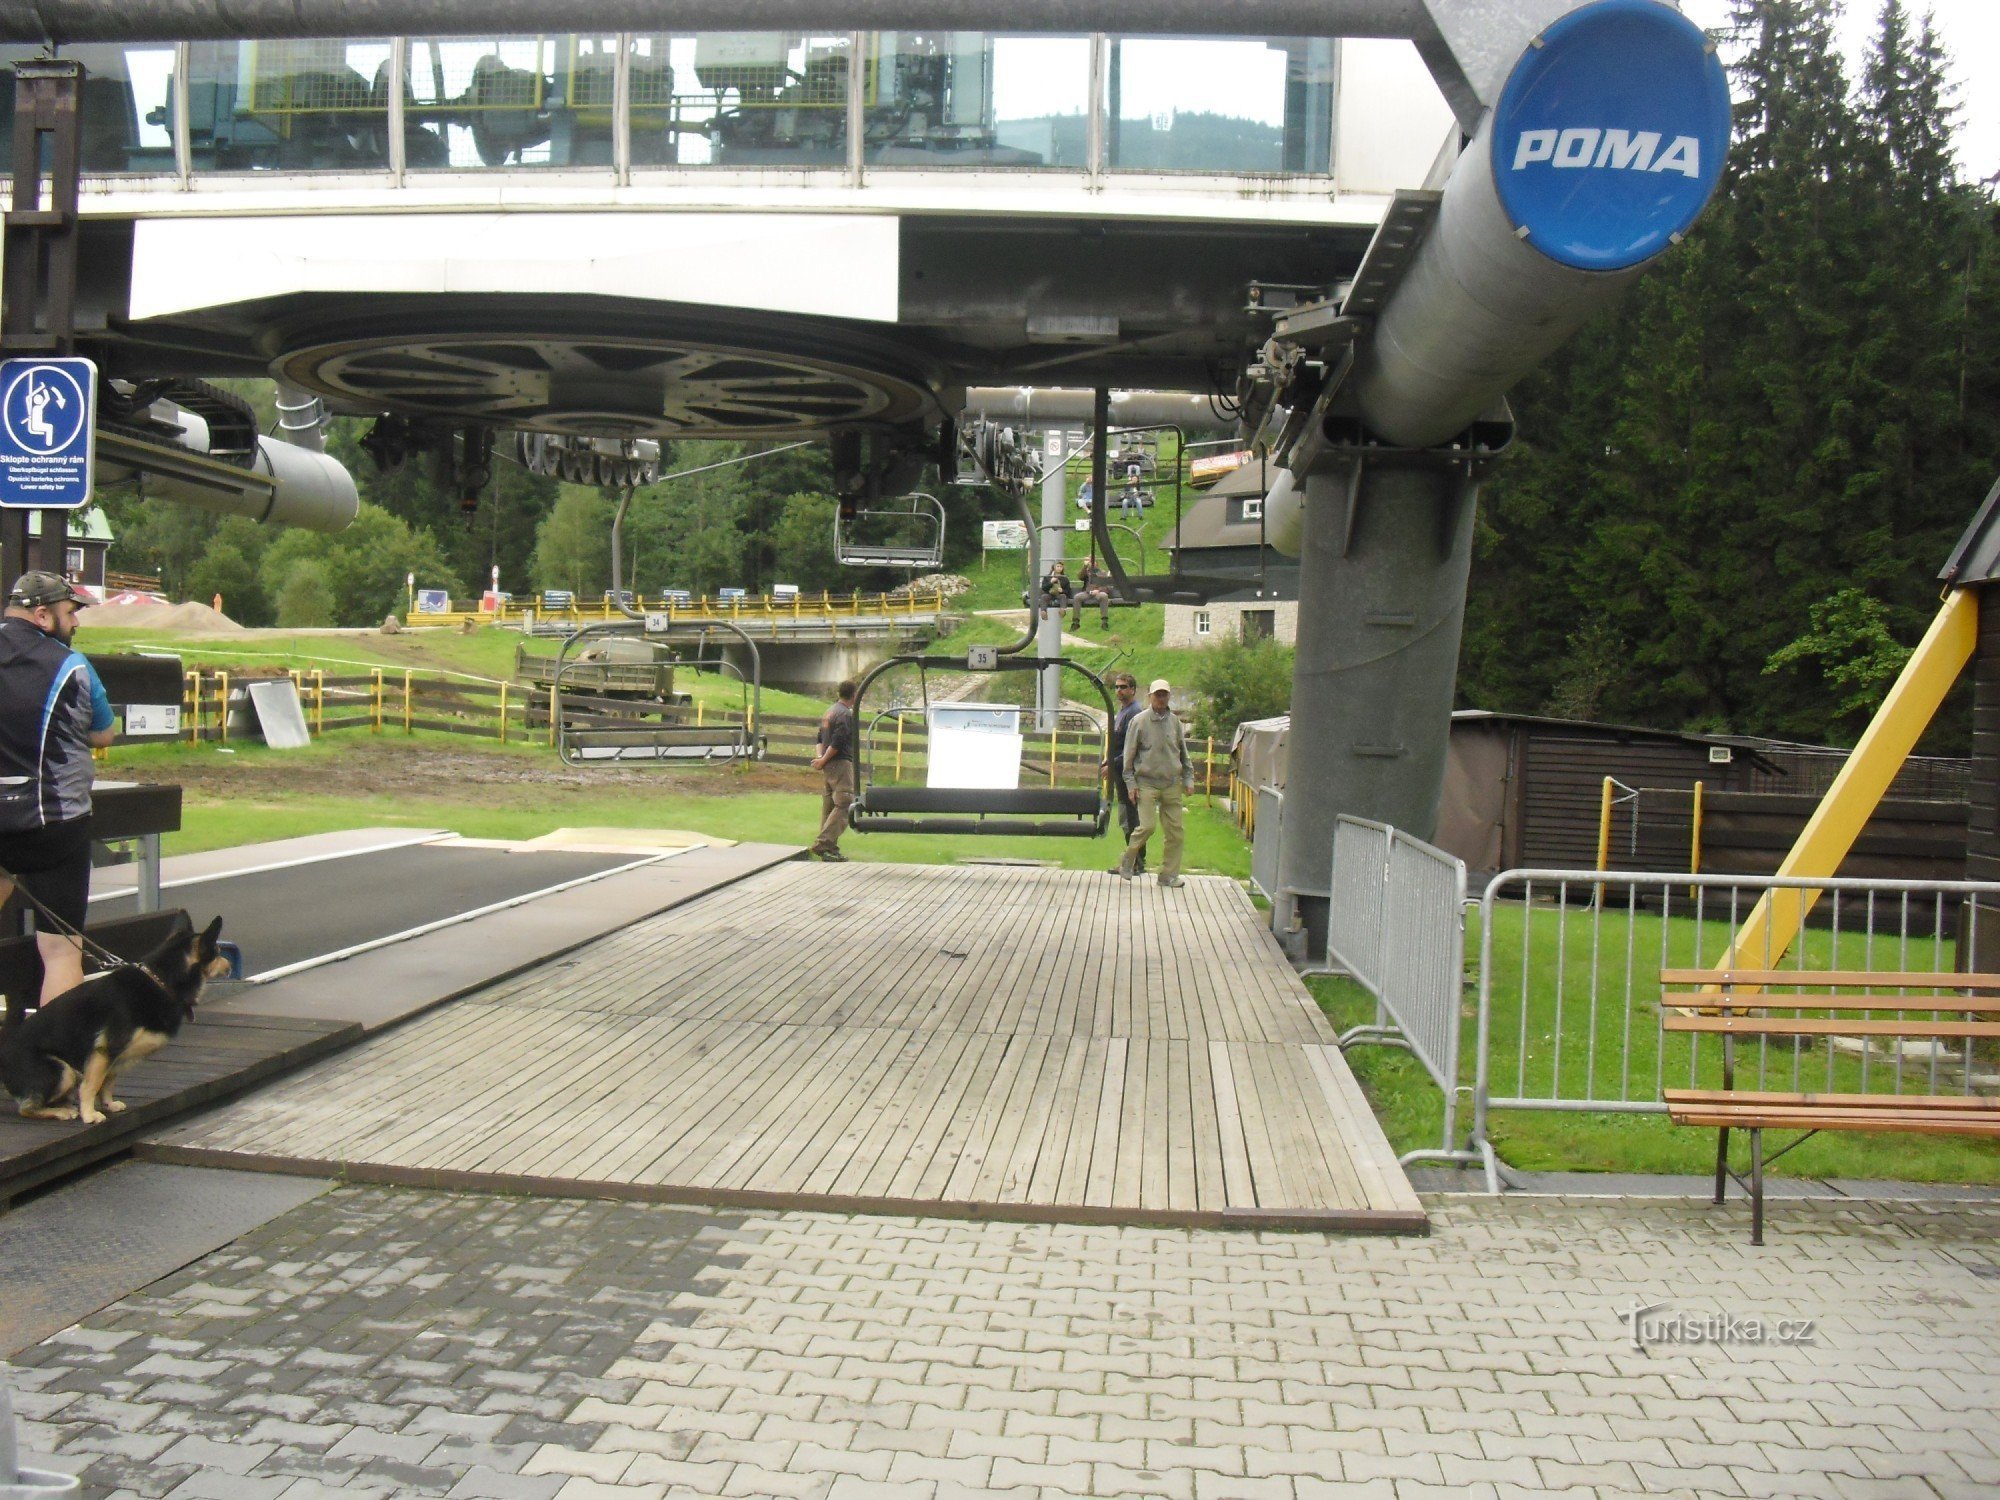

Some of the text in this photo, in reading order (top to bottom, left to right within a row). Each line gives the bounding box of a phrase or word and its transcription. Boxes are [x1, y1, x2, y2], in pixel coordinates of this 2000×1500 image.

[1512, 128, 1699, 178] POMA
[0, 455, 85, 465] Sklopte ochranný rám
[652, 618, 660, 627] 34
[978, 653, 987, 663] 35
